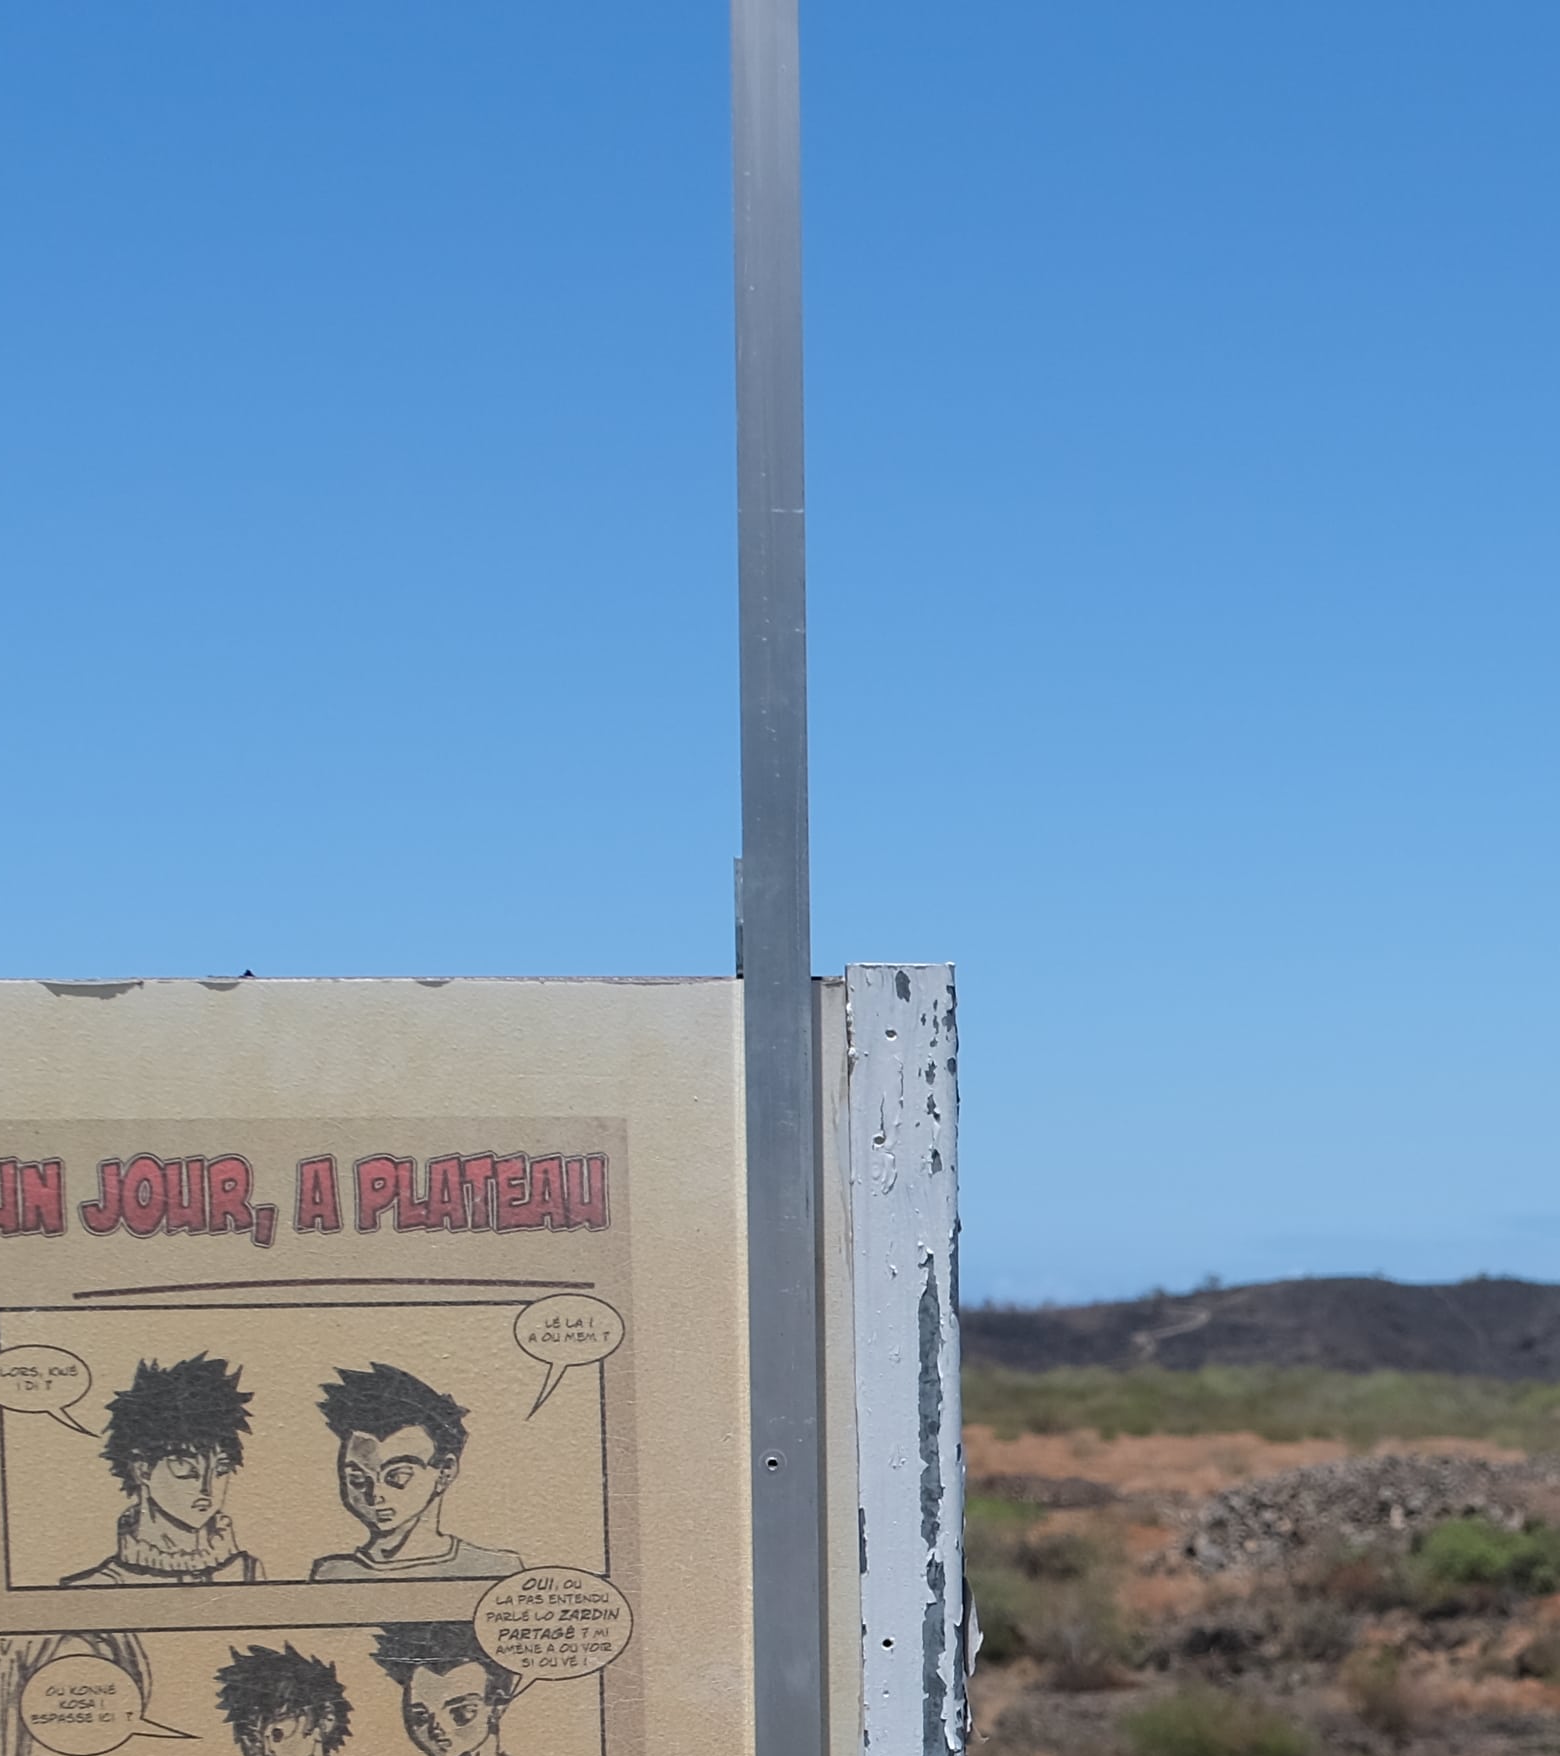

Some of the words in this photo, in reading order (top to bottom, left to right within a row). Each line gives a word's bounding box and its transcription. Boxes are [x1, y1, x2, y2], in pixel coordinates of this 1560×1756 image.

[79, 1153, 278, 1248] JOUR,
[295, 1155, 342, 1234] A
[354, 1152, 610, 1234] PLATEAU
[563, 1579, 582, 1589] OU
[518, 1595, 544, 1605] PAS
[549, 1593, 609, 1604] ENTENDU
[559, 1608, 620, 1622] ZARDIN
